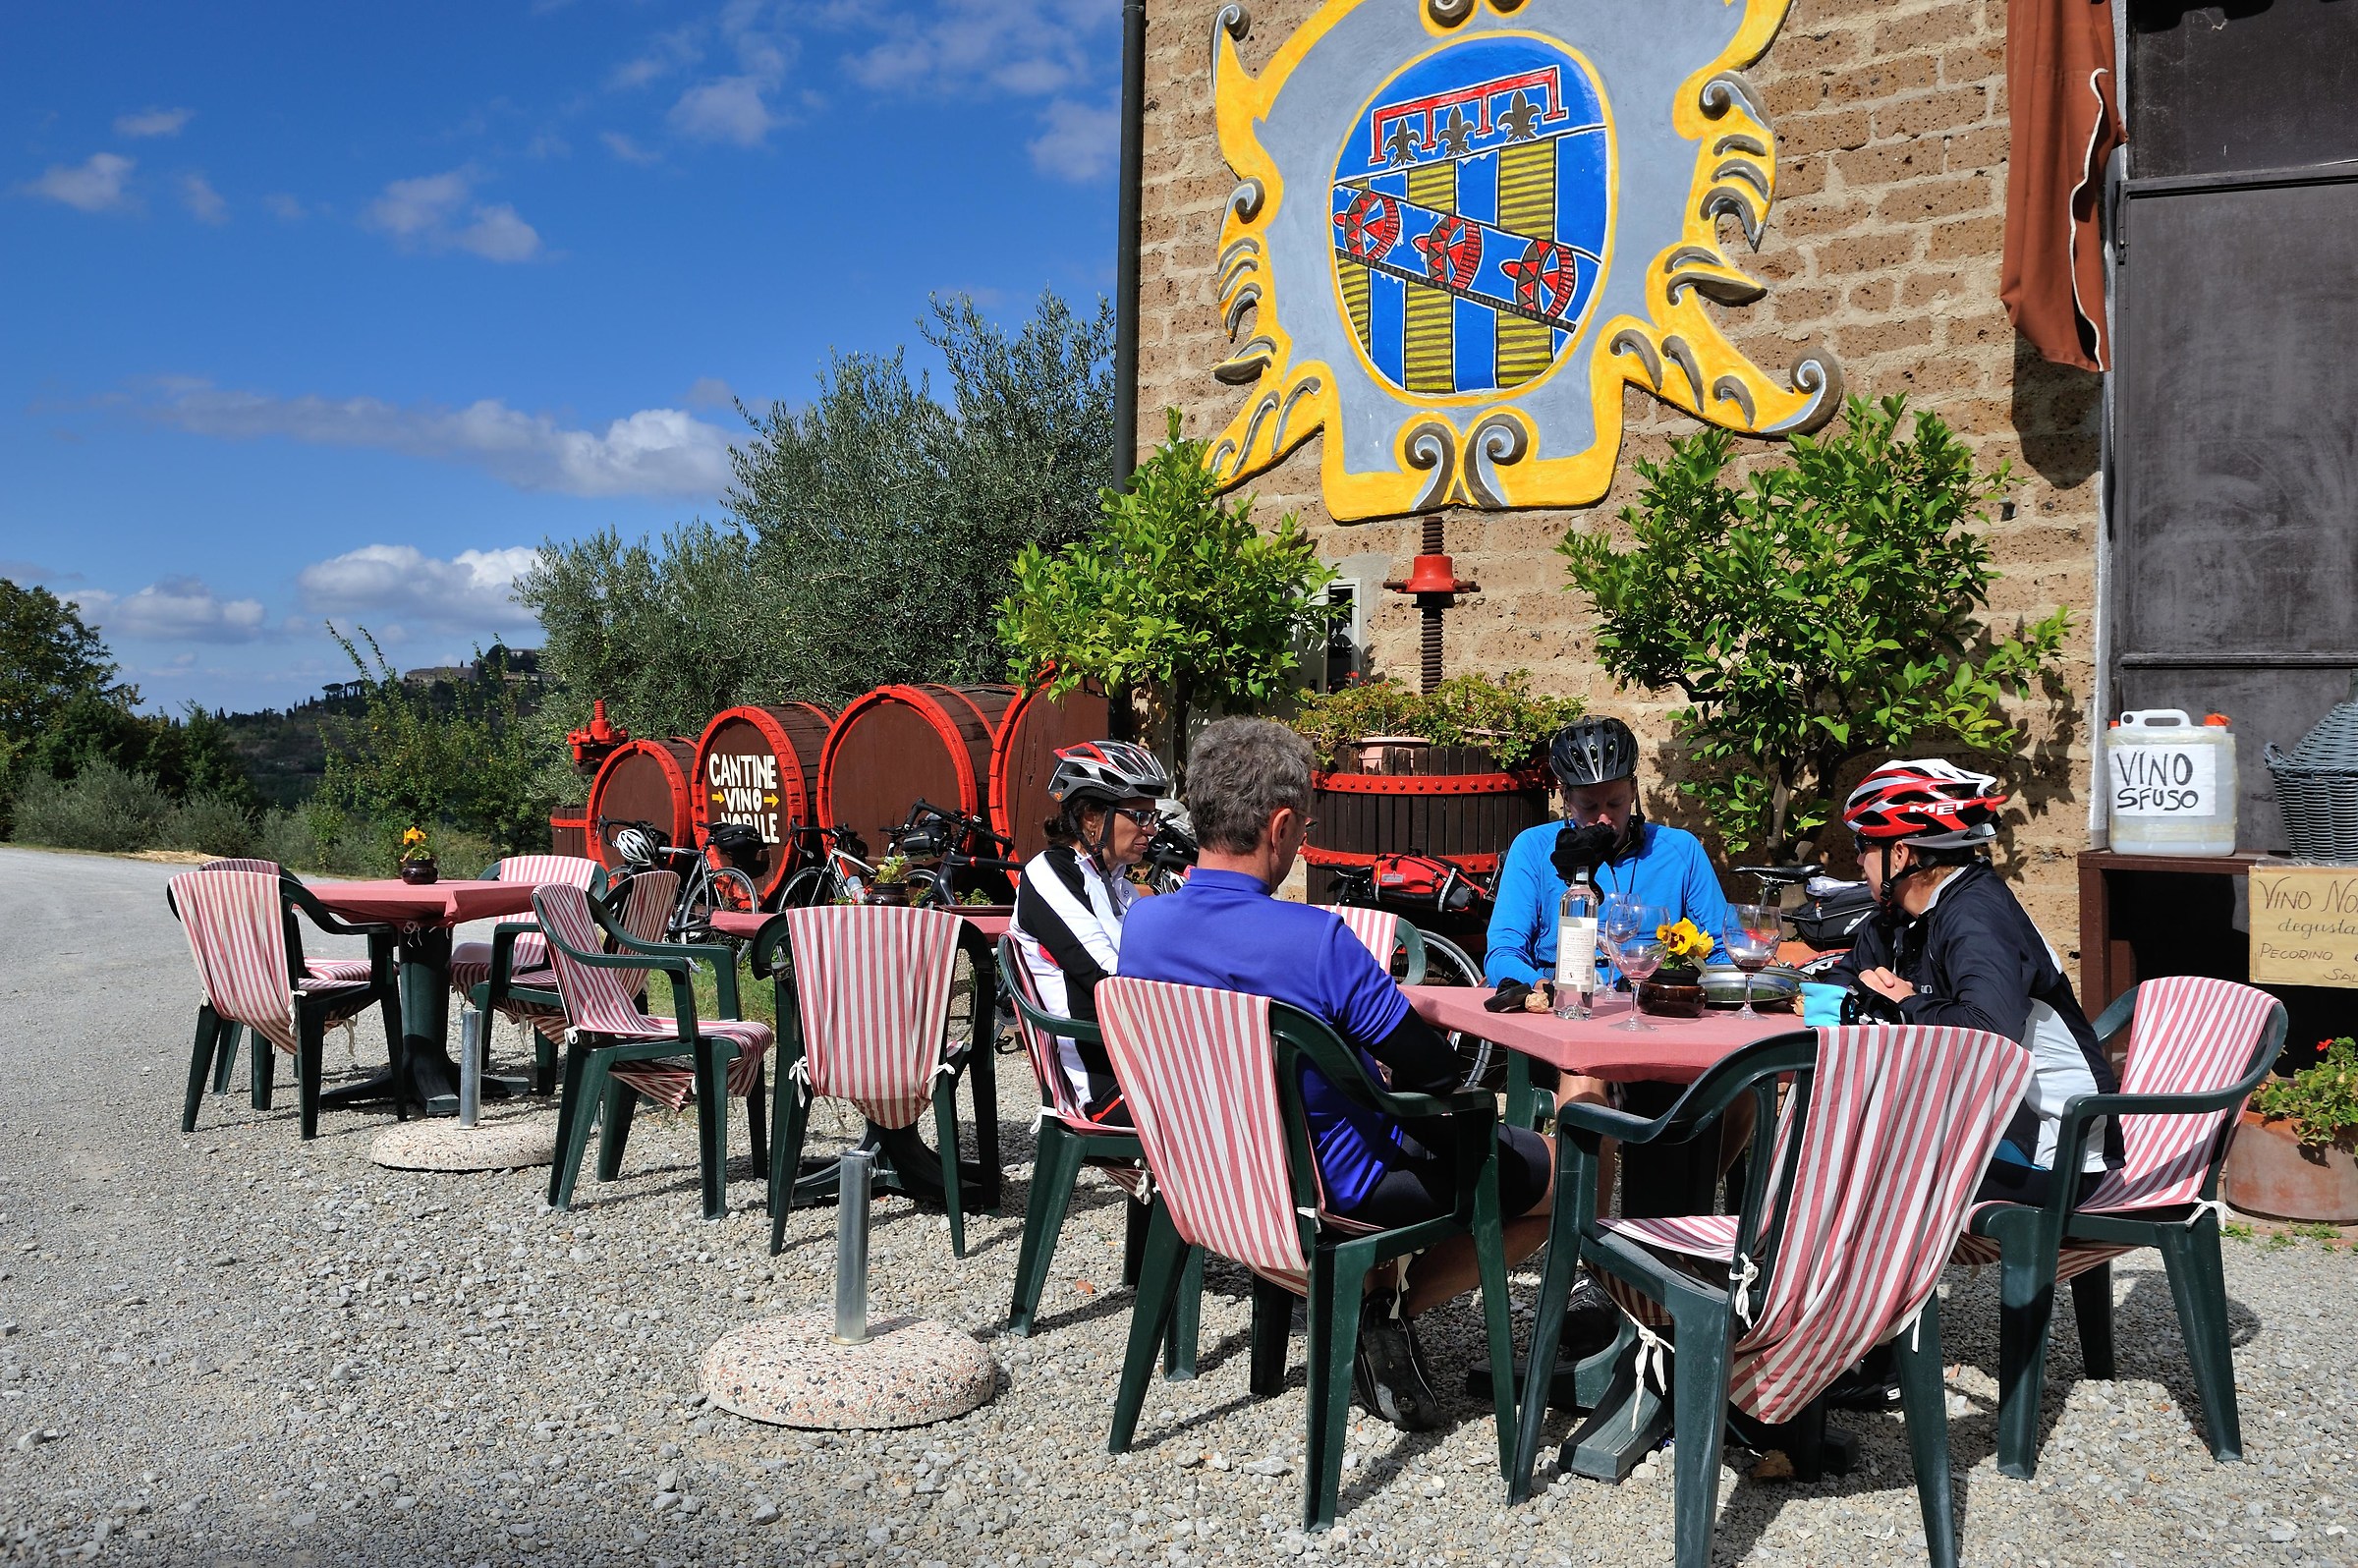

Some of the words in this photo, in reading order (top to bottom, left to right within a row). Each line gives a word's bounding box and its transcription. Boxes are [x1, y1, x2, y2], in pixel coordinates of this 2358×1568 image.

[708, 753, 777, 790] CANTINE
[2116, 750, 2193, 787] VINO
[723, 787, 762, 812] VINO
[1909, 800, 1970, 815] MET
[2116, 787, 2199, 812] SFUSO
[2320, 877, 2358, 914] NO
[2260, 942, 2333, 961] PECORINO
